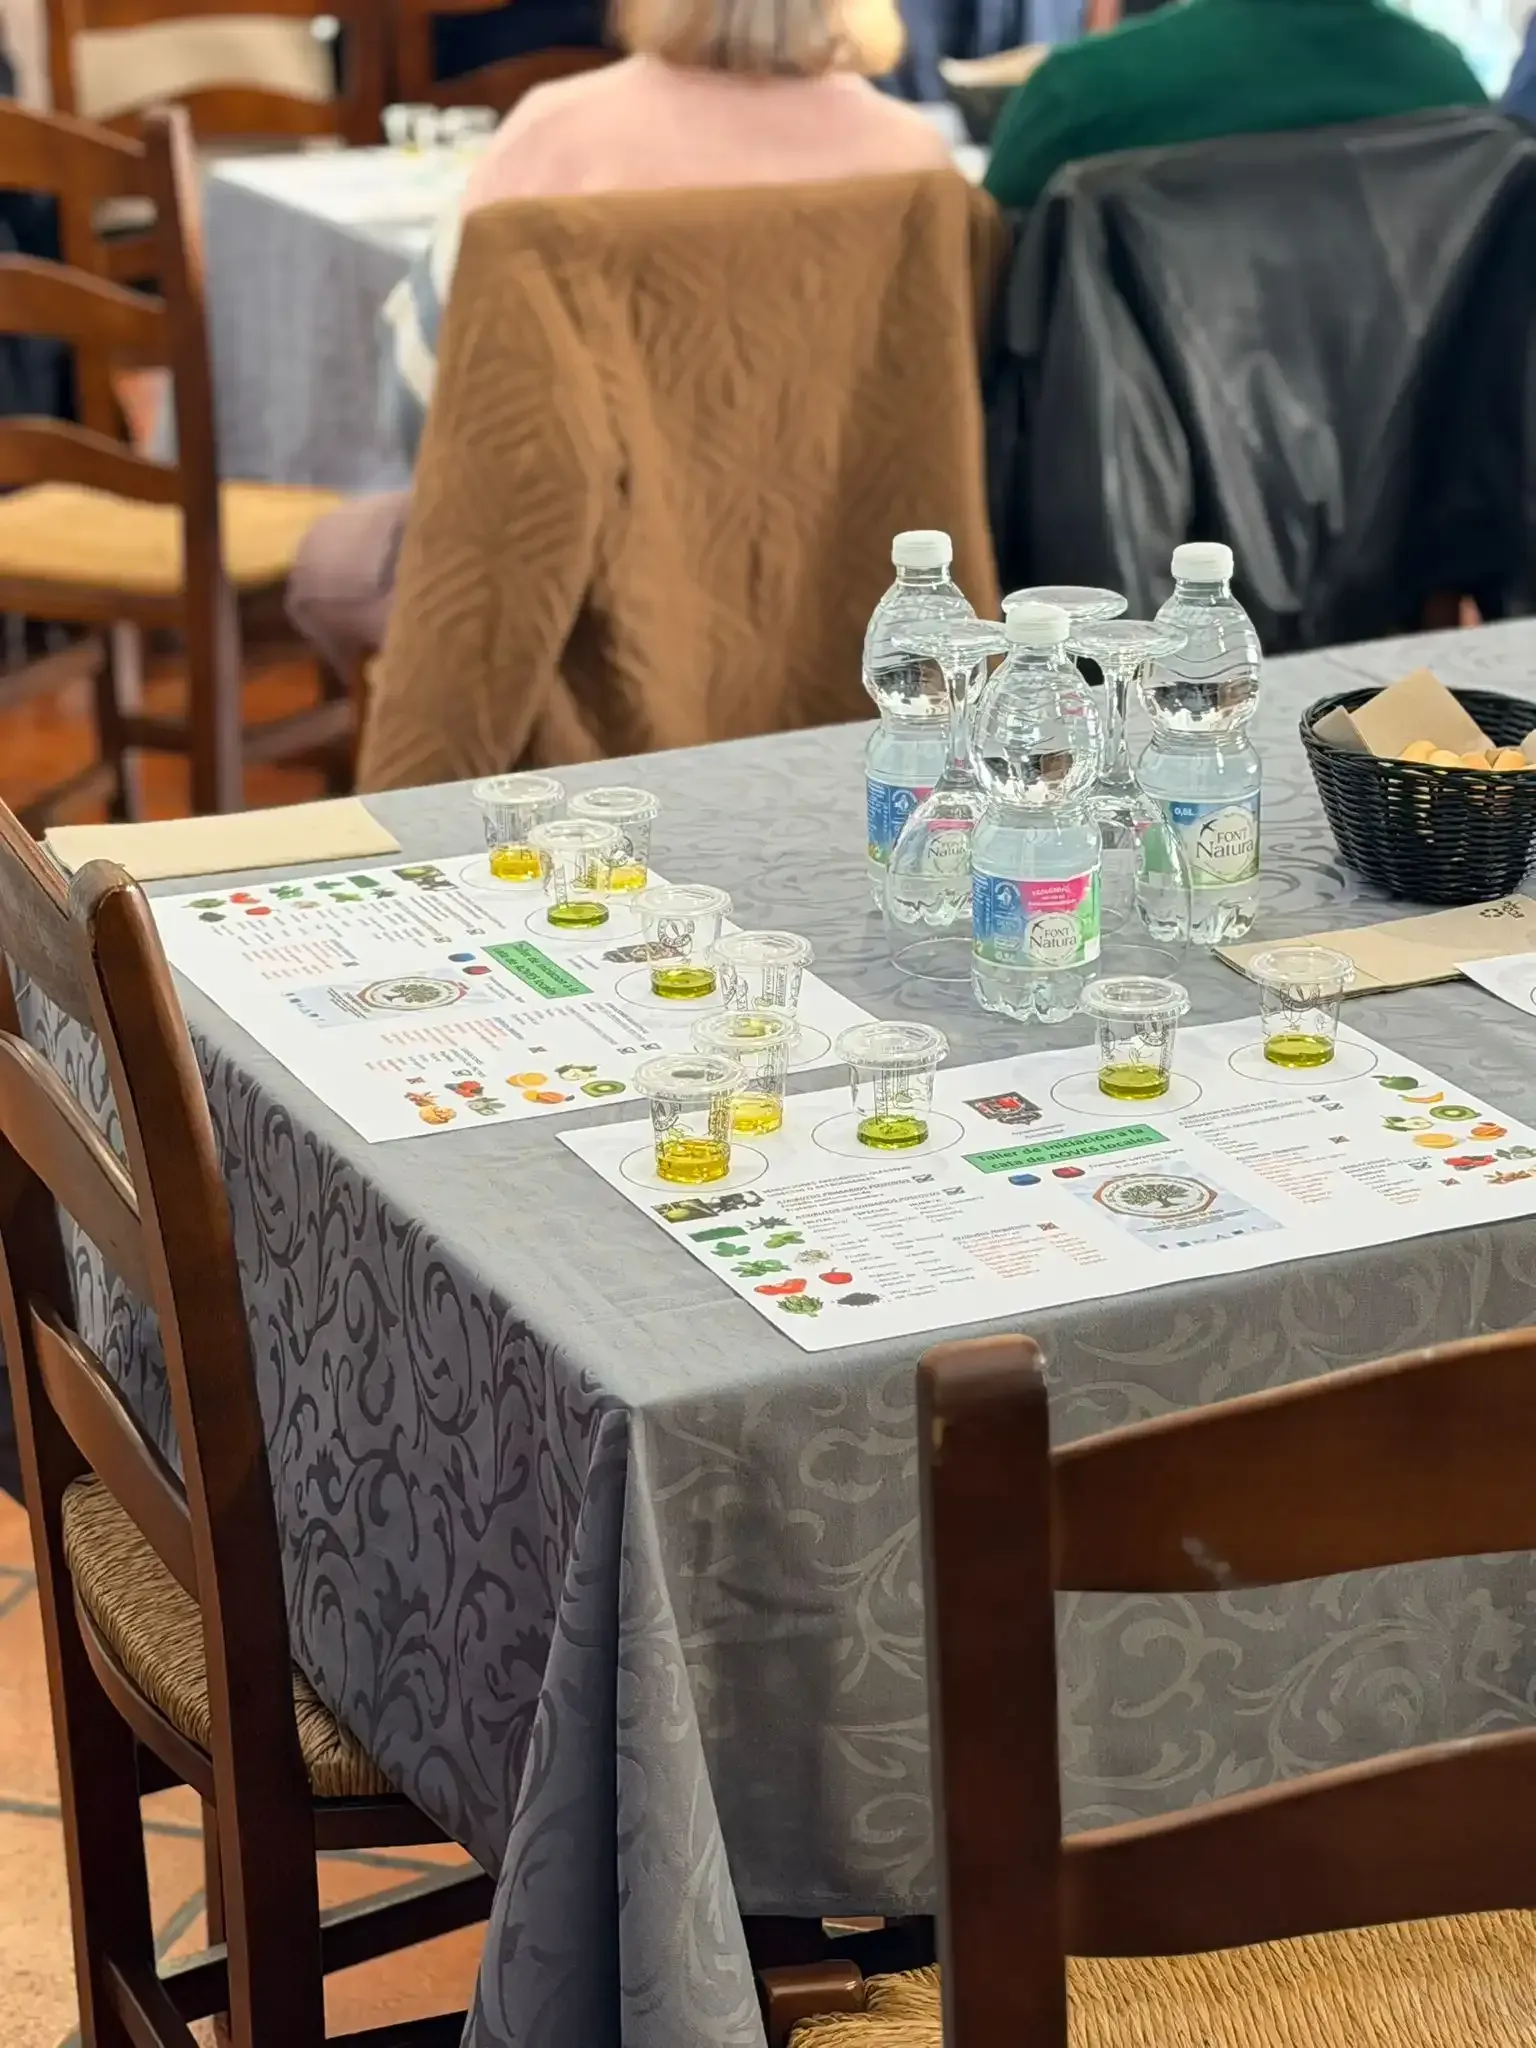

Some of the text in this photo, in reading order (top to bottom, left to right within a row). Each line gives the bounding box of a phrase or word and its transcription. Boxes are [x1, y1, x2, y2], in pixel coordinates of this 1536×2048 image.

[1217, 828, 1247, 843] FONT
[1196, 839, 1254, 859] Natura
[1044, 927, 1070, 938] FONT
[1029, 935, 1077, 949] Natura
[977, 1126, 1145, 1162] Taller de iniciación a la
[991, 1159, 1025, 1170] cata
[1026, 1154, 1045, 1164] de
[1049, 1145, 1100, 1160] AOVES
[1102, 1136, 1154, 1151] locales
